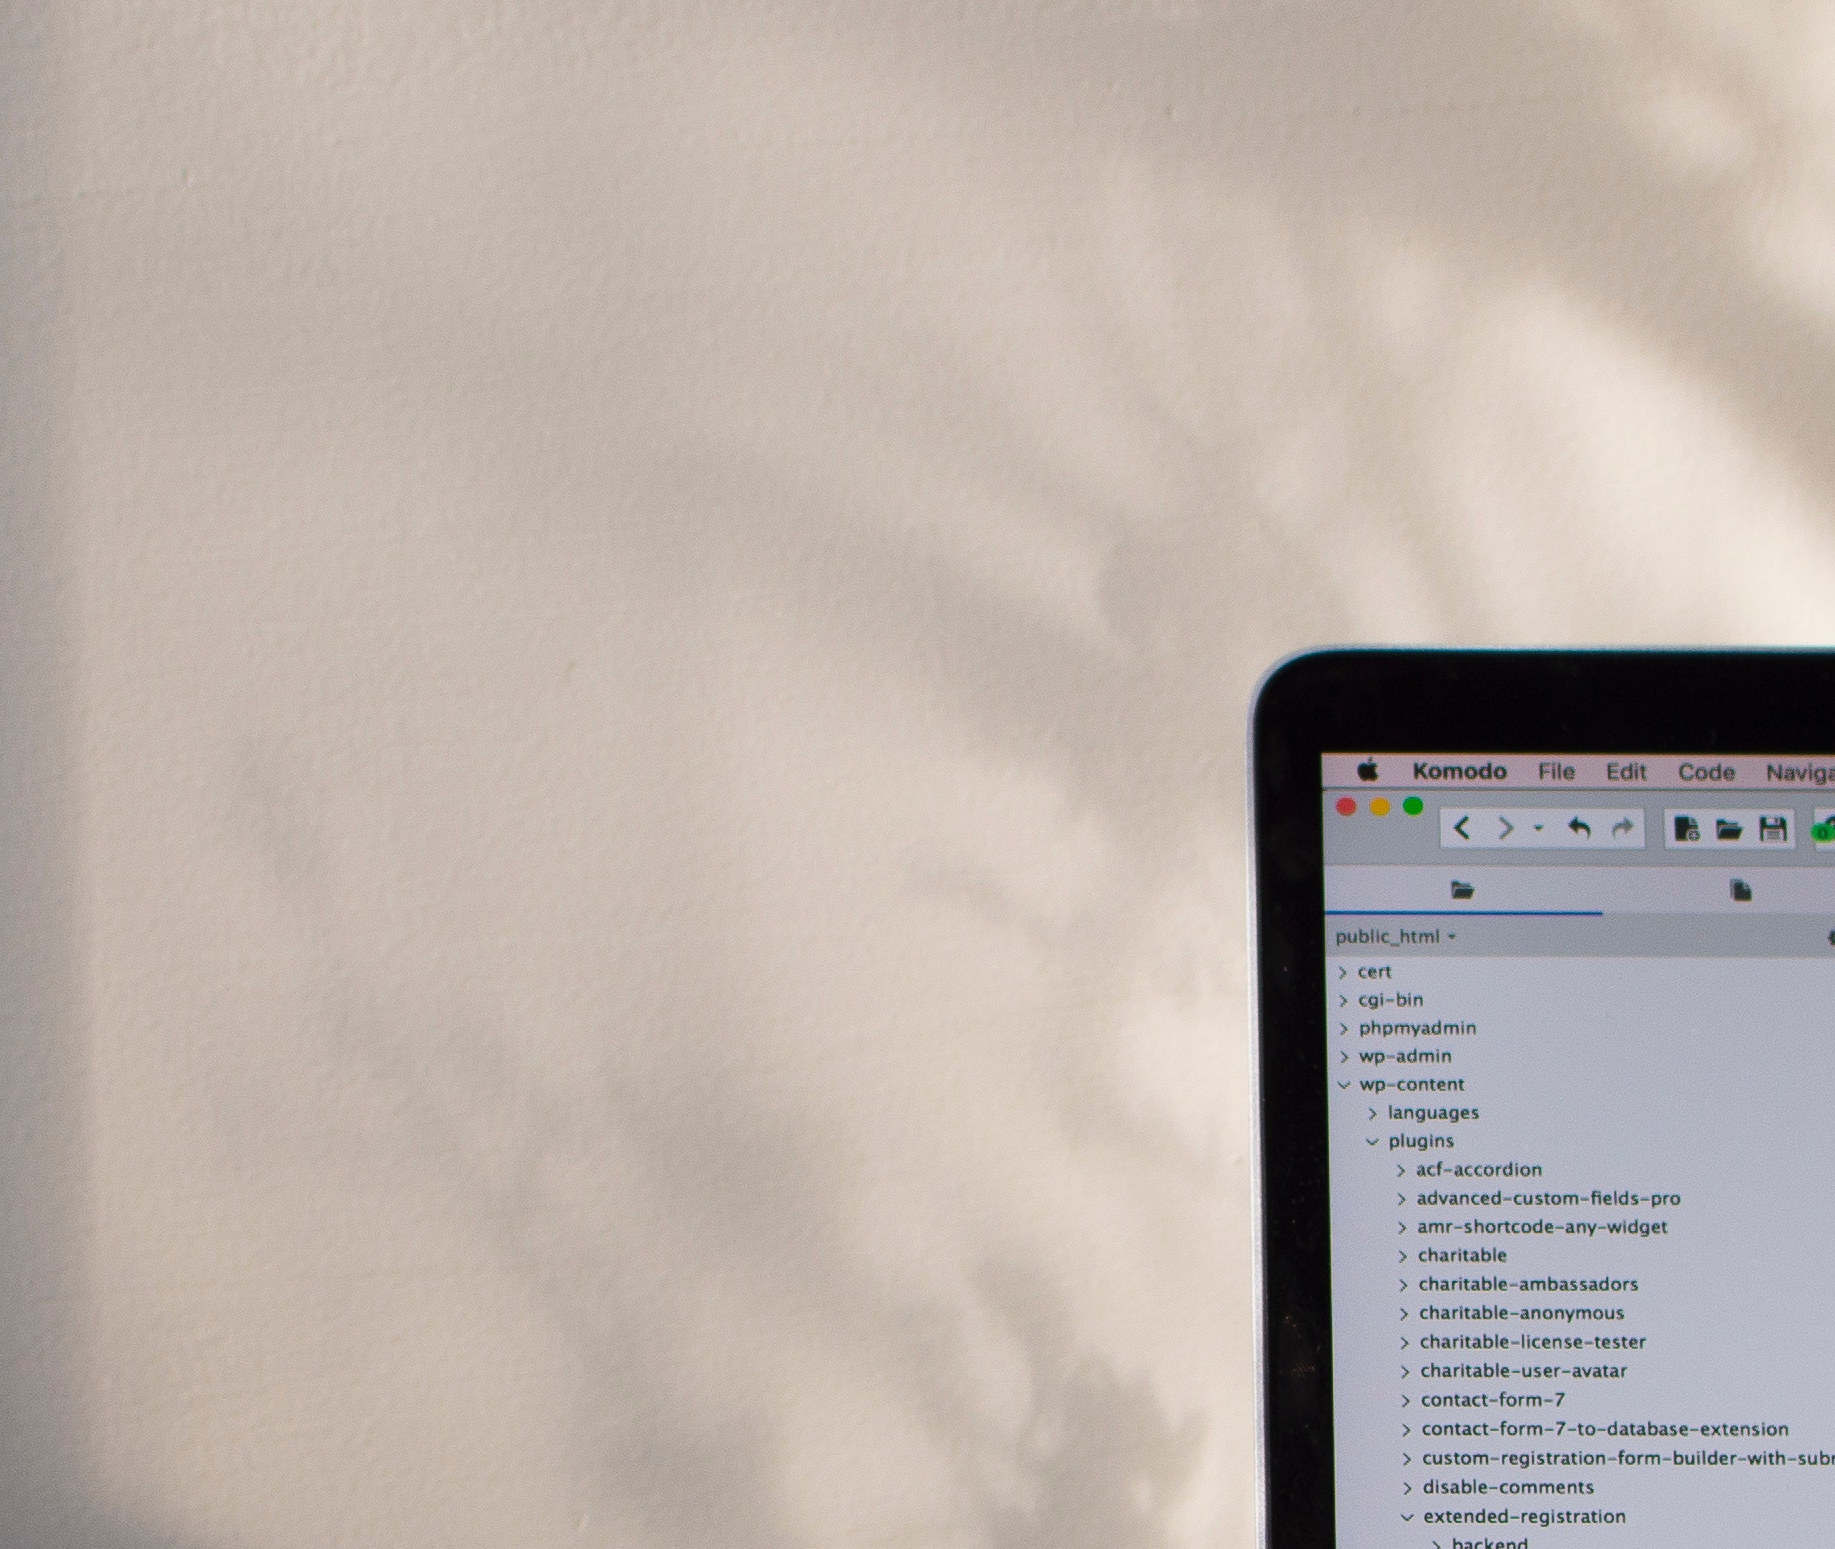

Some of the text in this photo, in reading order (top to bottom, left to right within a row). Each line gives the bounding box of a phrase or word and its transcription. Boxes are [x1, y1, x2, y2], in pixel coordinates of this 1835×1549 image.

[1413, 763, 1507, 780] Komodo
[1539, 763, 1575, 781] File
[1607, 763, 1647, 781] Edit
[1679, 763, 1735, 781] Code
[1336, 930, 1439, 946] public_html
[1358, 966, 1391, 978] cert
[1359, 993, 1423, 1009] cgi-bin
[1359, 1021, 1476, 1037] phpmyadmin
[1360, 1049, 1451, 1064] wp-admin
[1360, 1079, 1464, 1093] wp-content
[1389, 1106, 1479, 1123] languages
[1390, 1135, 1454, 1151] plugins
[1417, 1161, 1542, 1177] acf-accordion
[1417, 1190, 1681, 1207] advanced-custom-fields-pro
[1418, 1220, 1667, 1237] amr-shortcode-any-widget
[1419, 1248, 1506, 1262] charitable
[1419, 1277, 1638, 1291] charitable-ambassadors
[1420, 1306, 1624, 1322] charitable-anonymous
[1420, 1335, 1646, 1349] charitable-license-tester
[1421, 1363, 1626, 1378] charitable-user-avatar
[1421, 1391, 1565, 1407] contact-form-7
[1422, 1421, 1788, 1436] contact-form-7-to-database-extension
[1423, 1480, 1594, 1494] disable-comments
[1424, 1509, 1625, 1527] extended-registration
